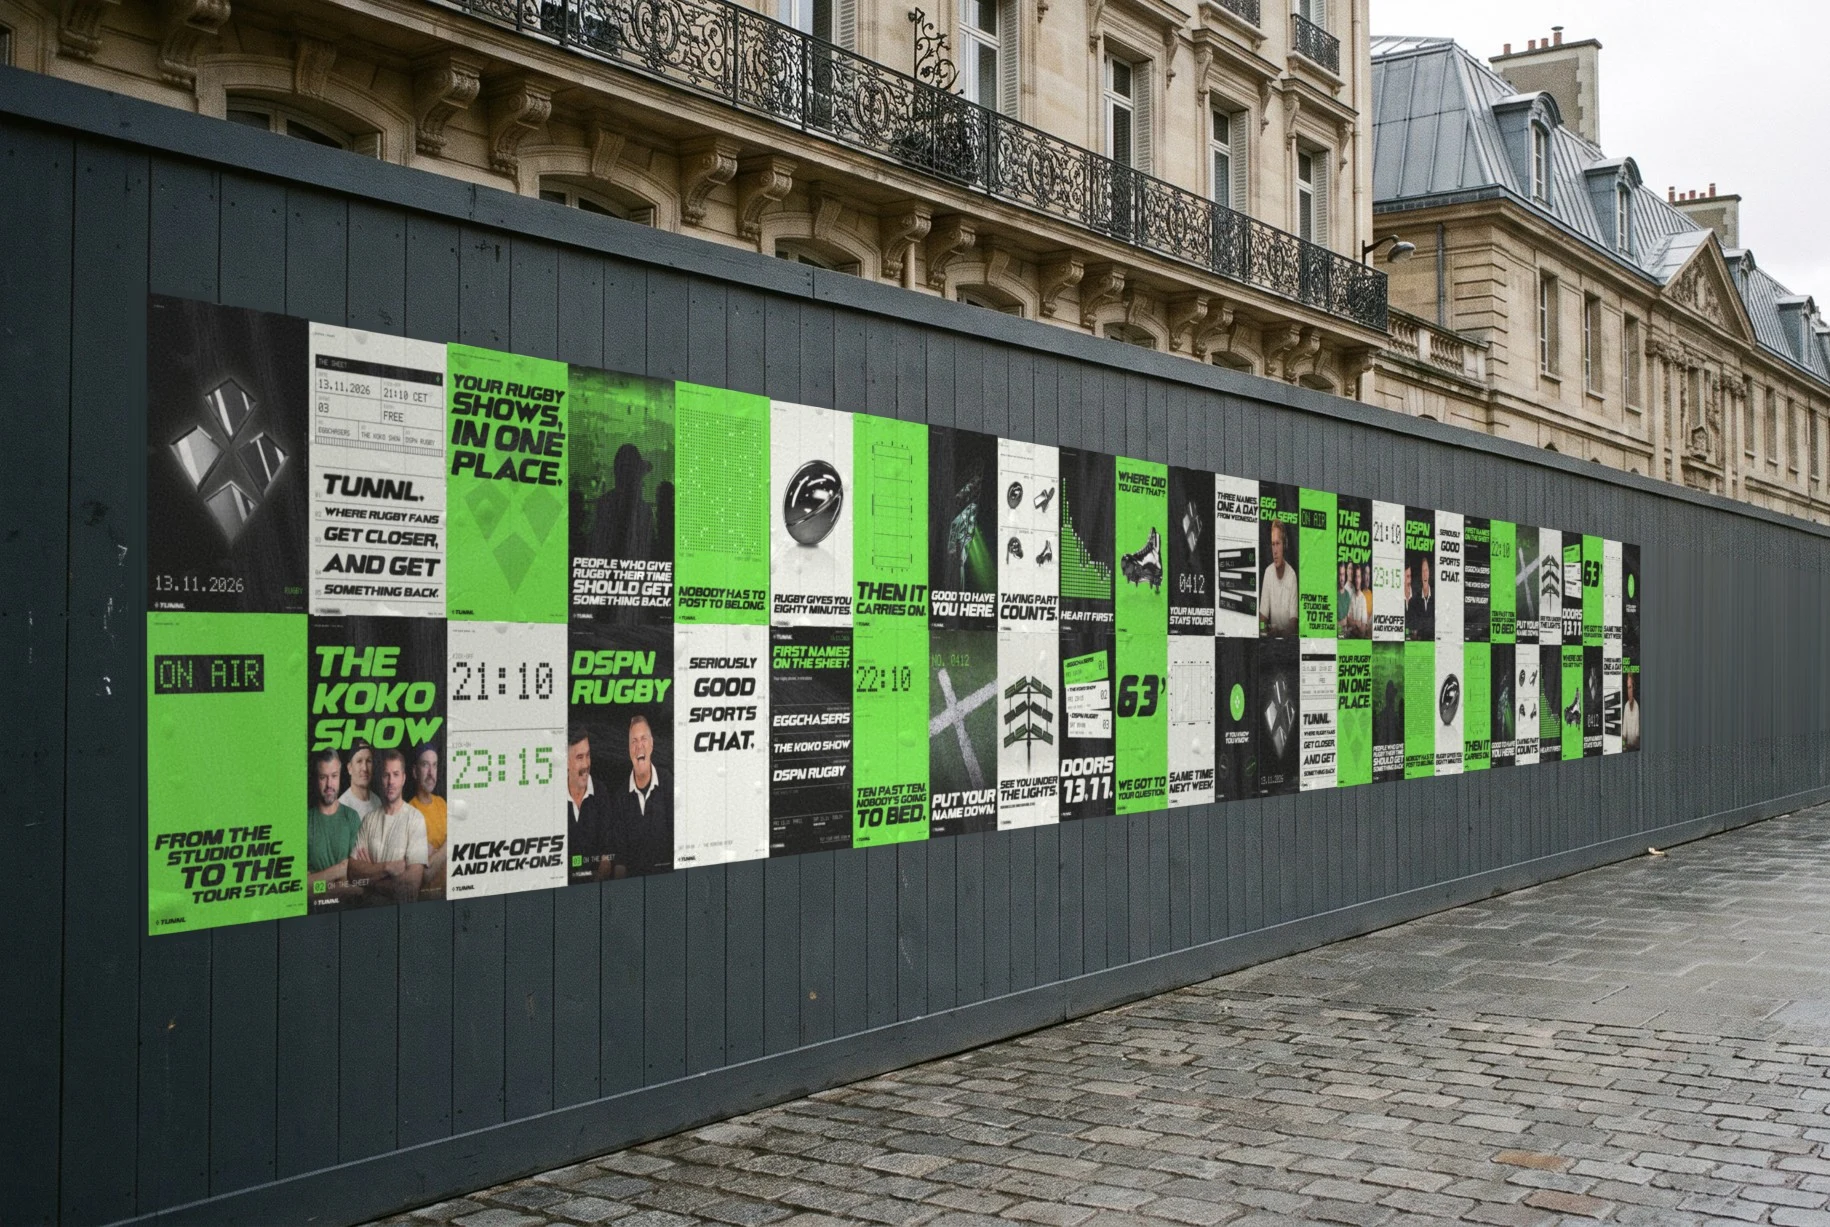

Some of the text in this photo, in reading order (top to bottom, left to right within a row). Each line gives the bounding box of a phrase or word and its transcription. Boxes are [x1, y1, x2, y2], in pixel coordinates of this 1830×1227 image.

[319, 379, 370, 395] 13.11.2026
[454, 373, 565, 404] YOUR RUGBY
[384, 388, 428, 403] 21:10 CET
[318, 402, 329, 413] 03
[451, 391, 563, 432] SHOWS,
[384, 411, 404, 422] FREE
[451, 418, 566, 458] IN ONE
[451, 450, 563, 486] PLACE.
[1118, 470, 1166, 488] WHERE DID
[324, 474, 424, 502] TUNNL.
[1217, 501, 1258, 516] ONE A DAY
[1260, 497, 1276, 509] EGG
[325, 507, 439, 524] WHERE RUGBY FANS
[1260, 509, 1298, 524] CHASERS
[1338, 509, 1360, 528] THE
[1373, 521, 1401, 544] 21:10
[1406, 520, 1430, 536] DSPN
[324, 527, 438, 550] GET CLOSER,
[1338, 527, 1370, 547] KOKO
[1405, 535, 1435, 552] RUGBY
[1441, 540, 1460, 553] GOOD
[1338, 546, 1371, 564] SHOW
[1440, 557, 1460, 567] SPORTS
[322, 553, 441, 577] AND GET
[573, 557, 672, 572] PEOPLE WHO GIVE
[573, 568, 672, 581] RUGBY THEIR TIME
[156, 575, 244, 592] 13.11.2026
[324, 584, 438, 598] SOMETHING BACK.
[572, 579, 672, 596] SHOULD GET
[857, 581, 927, 602] THEN IT
[1180, 573, 1205, 594] 0412
[573, 595, 671, 607] SOMETHING BACK.
[679, 586, 766, 600] NOBODY HAS TO
[774, 594, 852, 605] RUGBY GIVES YOU
[931, 590, 995, 603] GOOD TO HAVE
[1001, 593, 1058, 605] TAKING PART
[1301, 593, 1317, 602] FROM
[679, 598, 765, 610] POST TO BELONG.
[774, 604, 851, 615] EIGHTY MINUTES.
[856, 603, 926, 616] CARRIES ON.
[932, 602, 994, 618] YOU HERE.
[1170, 607, 1214, 616] YOUR NUMBER
[1000, 604, 1058, 621] COUNTS.
[1060, 610, 1114, 622] HEAR IT FIRST.
[1307, 611, 1333, 623] TO THE
[1563, 608, 1582, 620] DOORS
[773, 645, 851, 657] FIRST NAMES
[316, 646, 400, 677] THE
[571, 650, 656, 675] DSPN
[689, 657, 757, 669] SERIOUSLY
[773, 658, 850, 669] ON THE SHEET.
[160, 660, 259, 688] ON AIR
[452, 662, 552, 700] 21:10
[856, 666, 910, 692] 22:10
[571, 679, 672, 705] RUGBY
[694, 677, 756, 697] GOOD
[1339, 678, 1371, 693] IN ONE
[312, 682, 436, 714] KOKO
[688, 705, 757, 723] SPORTS
[773, 712, 850, 727] EGGCHASERS
[311, 716, 444, 752] SHOW
[694, 730, 755, 752] CHAT.
[774, 740, 850, 753] THE KOKO SHOW
[1465, 740, 1490, 752] THEN IT
[1060, 755, 1114, 777] DOORS
[1303, 752, 1335, 765] AND GET
[452, 747, 553, 789] 23:15
[773, 765, 846, 781] DSPN RUGBY
[1169, 769, 1214, 782] SAME TIME
[857, 783, 926, 798] TEN PAST TEN.
[1000, 776, 1058, 789] SEE YOU UNDER
[1063, 776, 1113, 804] 13.11.
[1118, 776, 1166, 790] WE GOT TO
[1169, 780, 1213, 794] NEXT WEEK.
[932, 788, 996, 809] PUT YOUR
[1000, 785, 1058, 801] THE LIGHTS.
[858, 804, 926, 828] TO BED.
[932, 808, 963, 821] NAME
[964, 804, 995, 818] DOWN.
[155, 825, 272, 850] FROM THE
[167, 841, 283, 866] STUDIO MIC
[452, 835, 565, 862] KICK-OFFS
[181, 856, 295, 889] TO THE
[451, 853, 563, 877] AND KICK-ONS.
[192, 879, 303, 904] TOUR STAGE.
